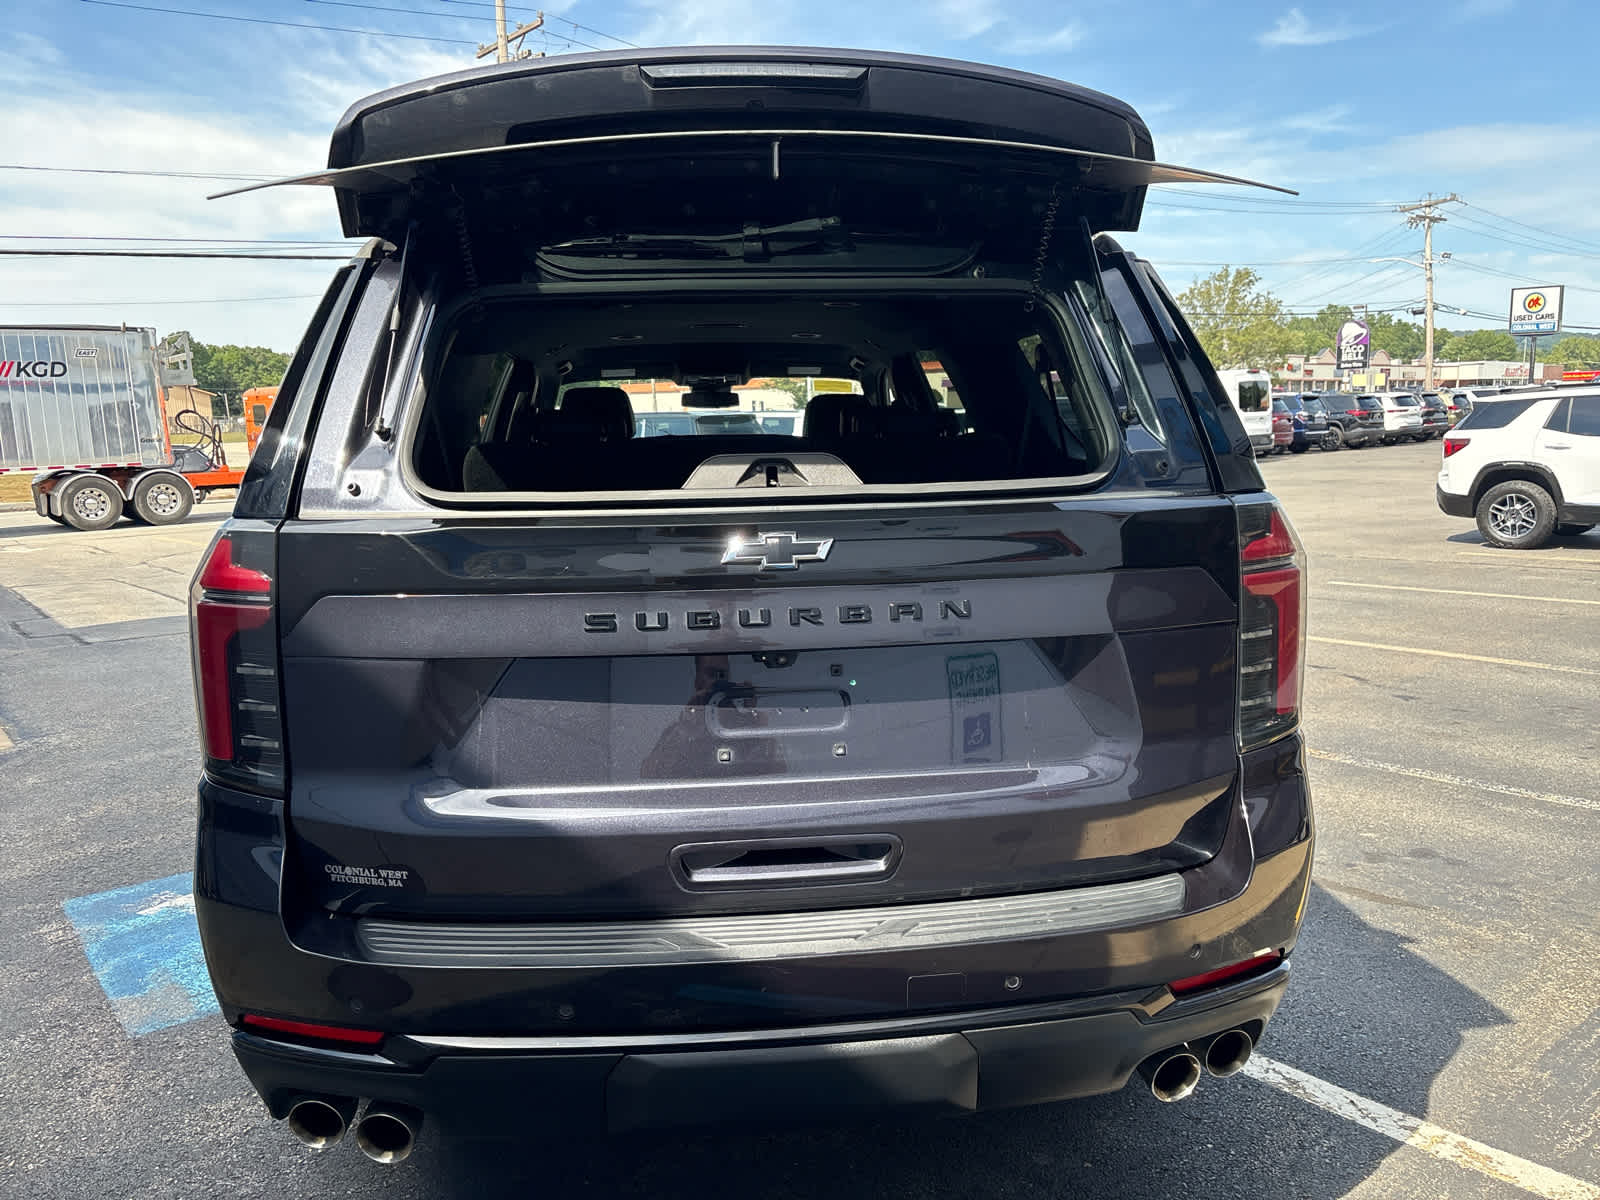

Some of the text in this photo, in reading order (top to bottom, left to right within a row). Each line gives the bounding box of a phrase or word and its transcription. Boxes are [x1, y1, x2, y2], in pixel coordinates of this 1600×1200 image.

[1527, 296, 1542, 309] OK
[1340, 344, 1365, 353] TACO
[1341, 351, 1364, 361] BELL
[16, 361, 67, 378] KGD
[584, 600, 972, 633] SUBURBAN
[324, 864, 408, 880] COLONIAL WEST
[388, 879, 403, 887] MA
